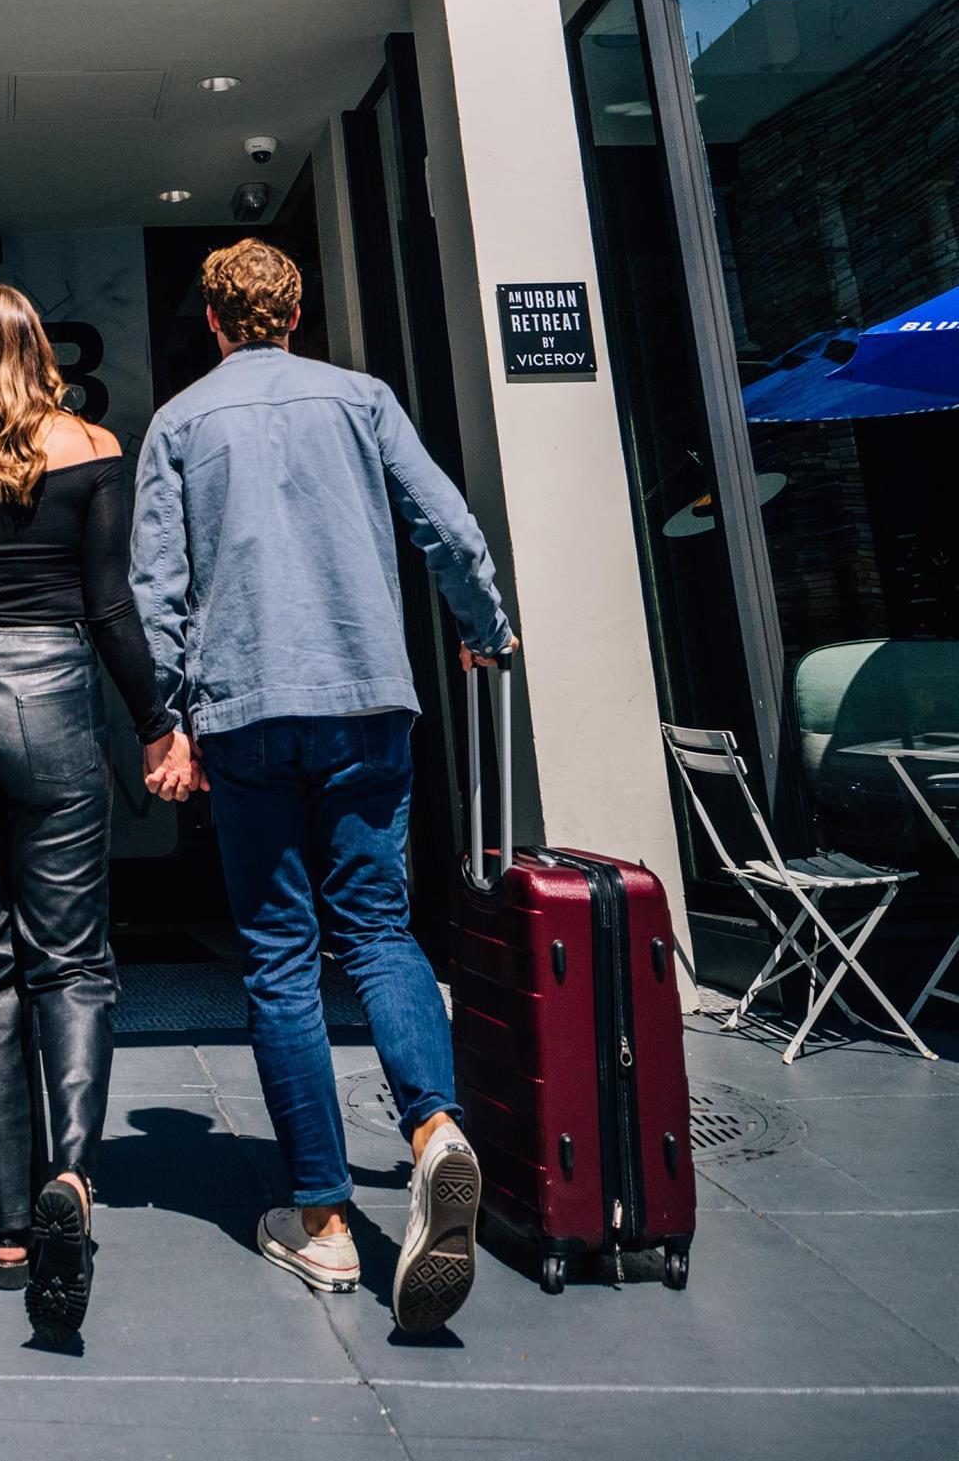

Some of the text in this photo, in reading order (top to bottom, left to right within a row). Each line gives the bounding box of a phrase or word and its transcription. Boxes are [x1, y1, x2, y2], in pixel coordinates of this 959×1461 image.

[508, 290, 578, 309] AN URBAN
[511, 313, 581, 332] RETREAT
[898, 321, 959, 332] BLU
[542, 336, 555, 348] BY
[516, 353, 586, 366] VICEROY
